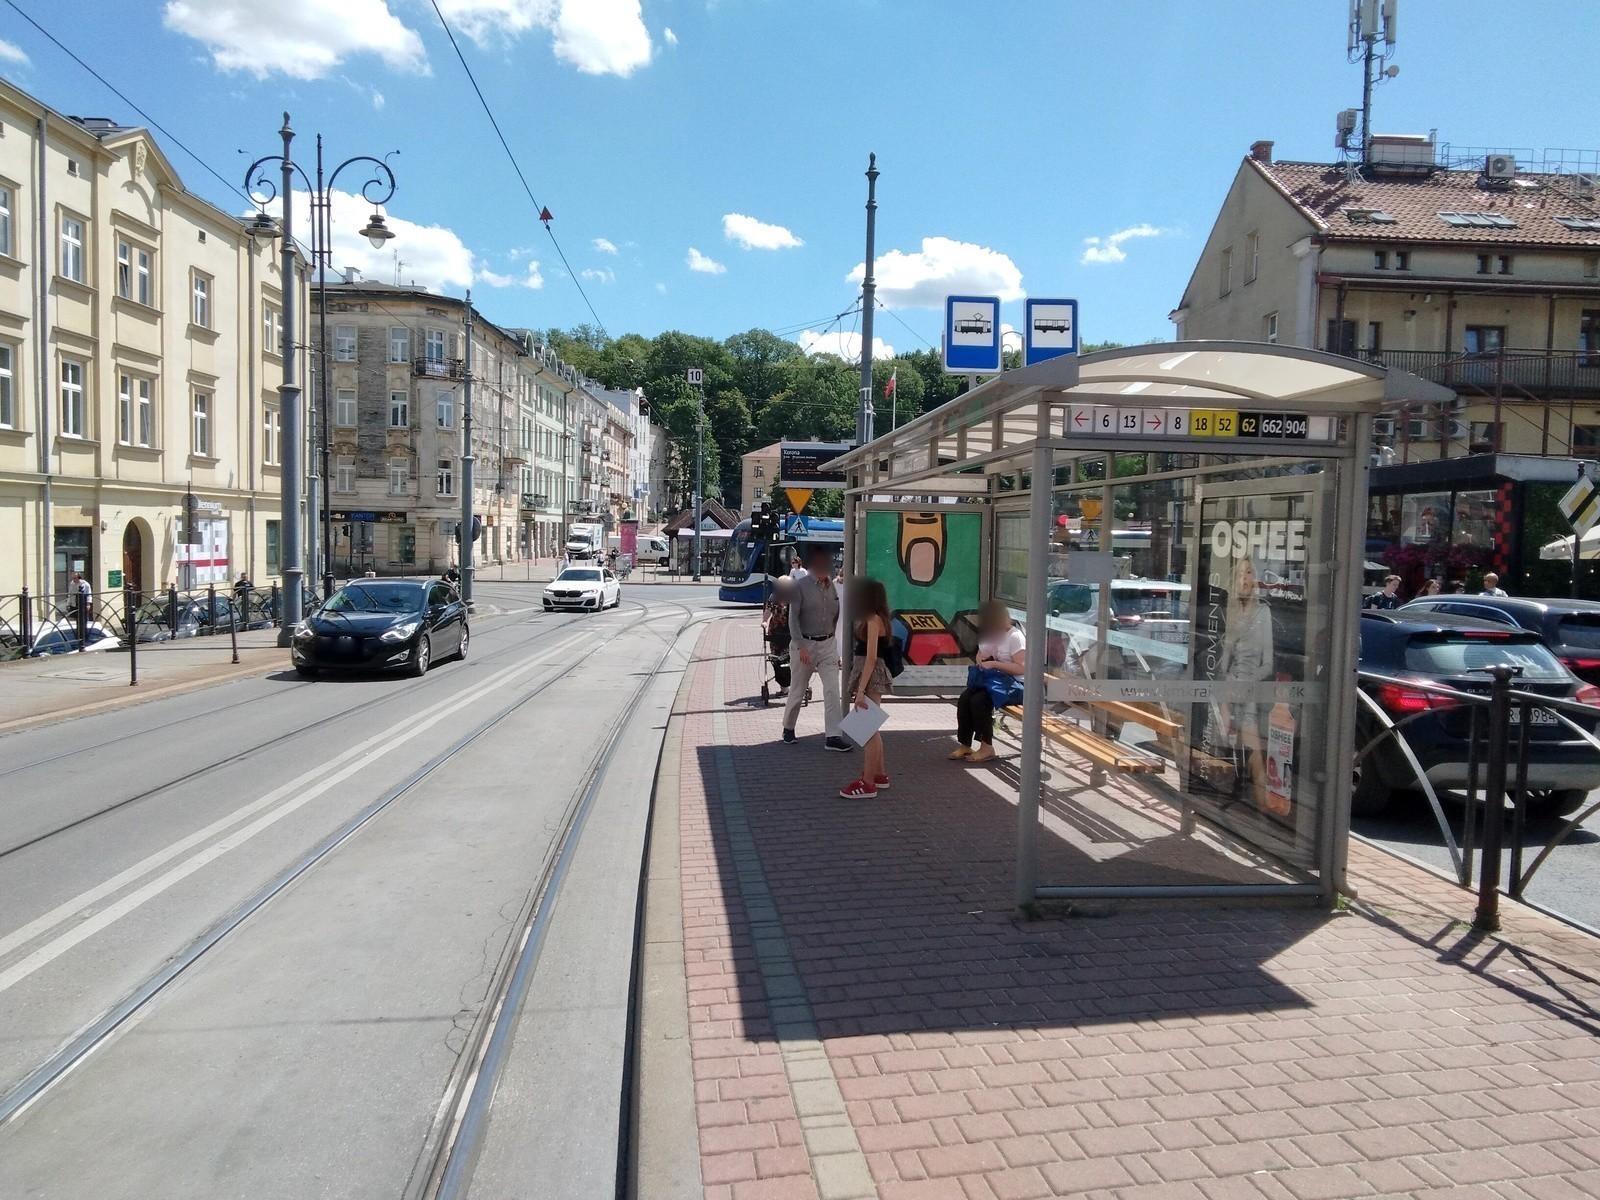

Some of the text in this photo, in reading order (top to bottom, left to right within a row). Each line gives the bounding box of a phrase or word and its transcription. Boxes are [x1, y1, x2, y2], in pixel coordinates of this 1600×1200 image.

[690, 370, 701, 381] 10
[1102, 414, 1306, 434] 6 13 8 18 52 62 662 904
[1211, 520, 1305, 560] OSHEE
[908, 615, 938, 628] ART
